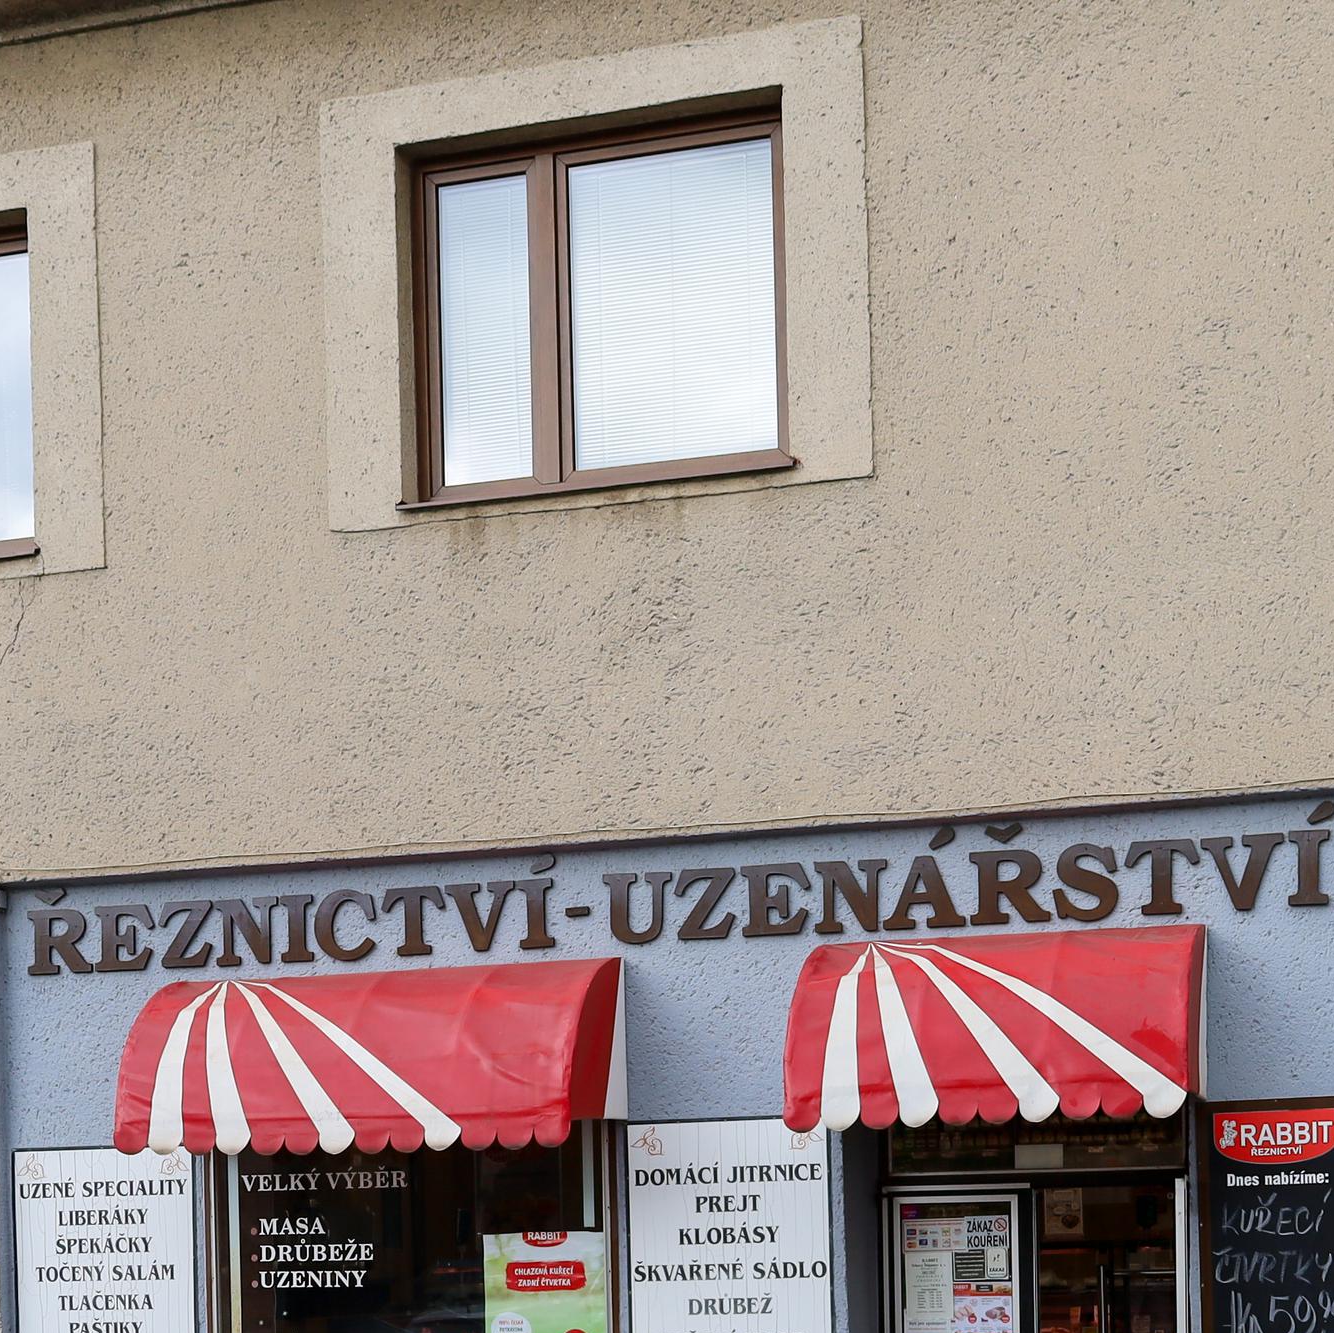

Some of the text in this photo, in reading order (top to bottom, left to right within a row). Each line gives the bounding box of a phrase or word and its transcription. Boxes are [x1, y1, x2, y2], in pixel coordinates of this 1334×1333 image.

[1240, 1120, 1333, 1147] RABBIT
[1250, 1145, 1302, 1157] ŘEZNICTVÍ
[241, 1166, 408, 1193] VELKÝ VÝBĚR
[634, 1163, 822, 1187] DOMÁCÍ JITRNICE
[1226, 1172, 1330, 1187] Dnes nabízíme:
[19, 1176, 188, 1200] UZENÉ SPECIALITY
[695, 1194, 761, 1213] PREJT
[1222, 1188, 1332, 1236] KUŘECÍ
[58, 1206, 148, 1227] LIBERÁKY
[259, 1217, 326, 1236] MASA
[967, 1218, 993, 1233] ZÁKAZ
[527, 1231, 561, 1240] RABBIT
[678, 1220, 780, 1245] KLOBÁSY
[967, 1233, 1007, 1248] KOUŘENÍ
[56, 1234, 153, 1255] ŠPEKÁČKY
[260, 1238, 374, 1262] DRŮBEŽE
[35, 1261, 175, 1284] TOČENÝ SALÁM
[514, 1264, 574, 1276] CHLAZENÁ KUŘECÍ
[634, 1255, 828, 1283] ŠKVAŘENÉ SÁDLO
[1212, 1248, 1332, 1285] ČTVRTKY
[259, 1270, 366, 1289] UZENINY
[517, 1275, 571, 1287] ZADNÍ ČTVRTKA
[58, 1291, 153, 1312] TLAČENKA
[688, 1292, 773, 1316] DRŮBEŽ
